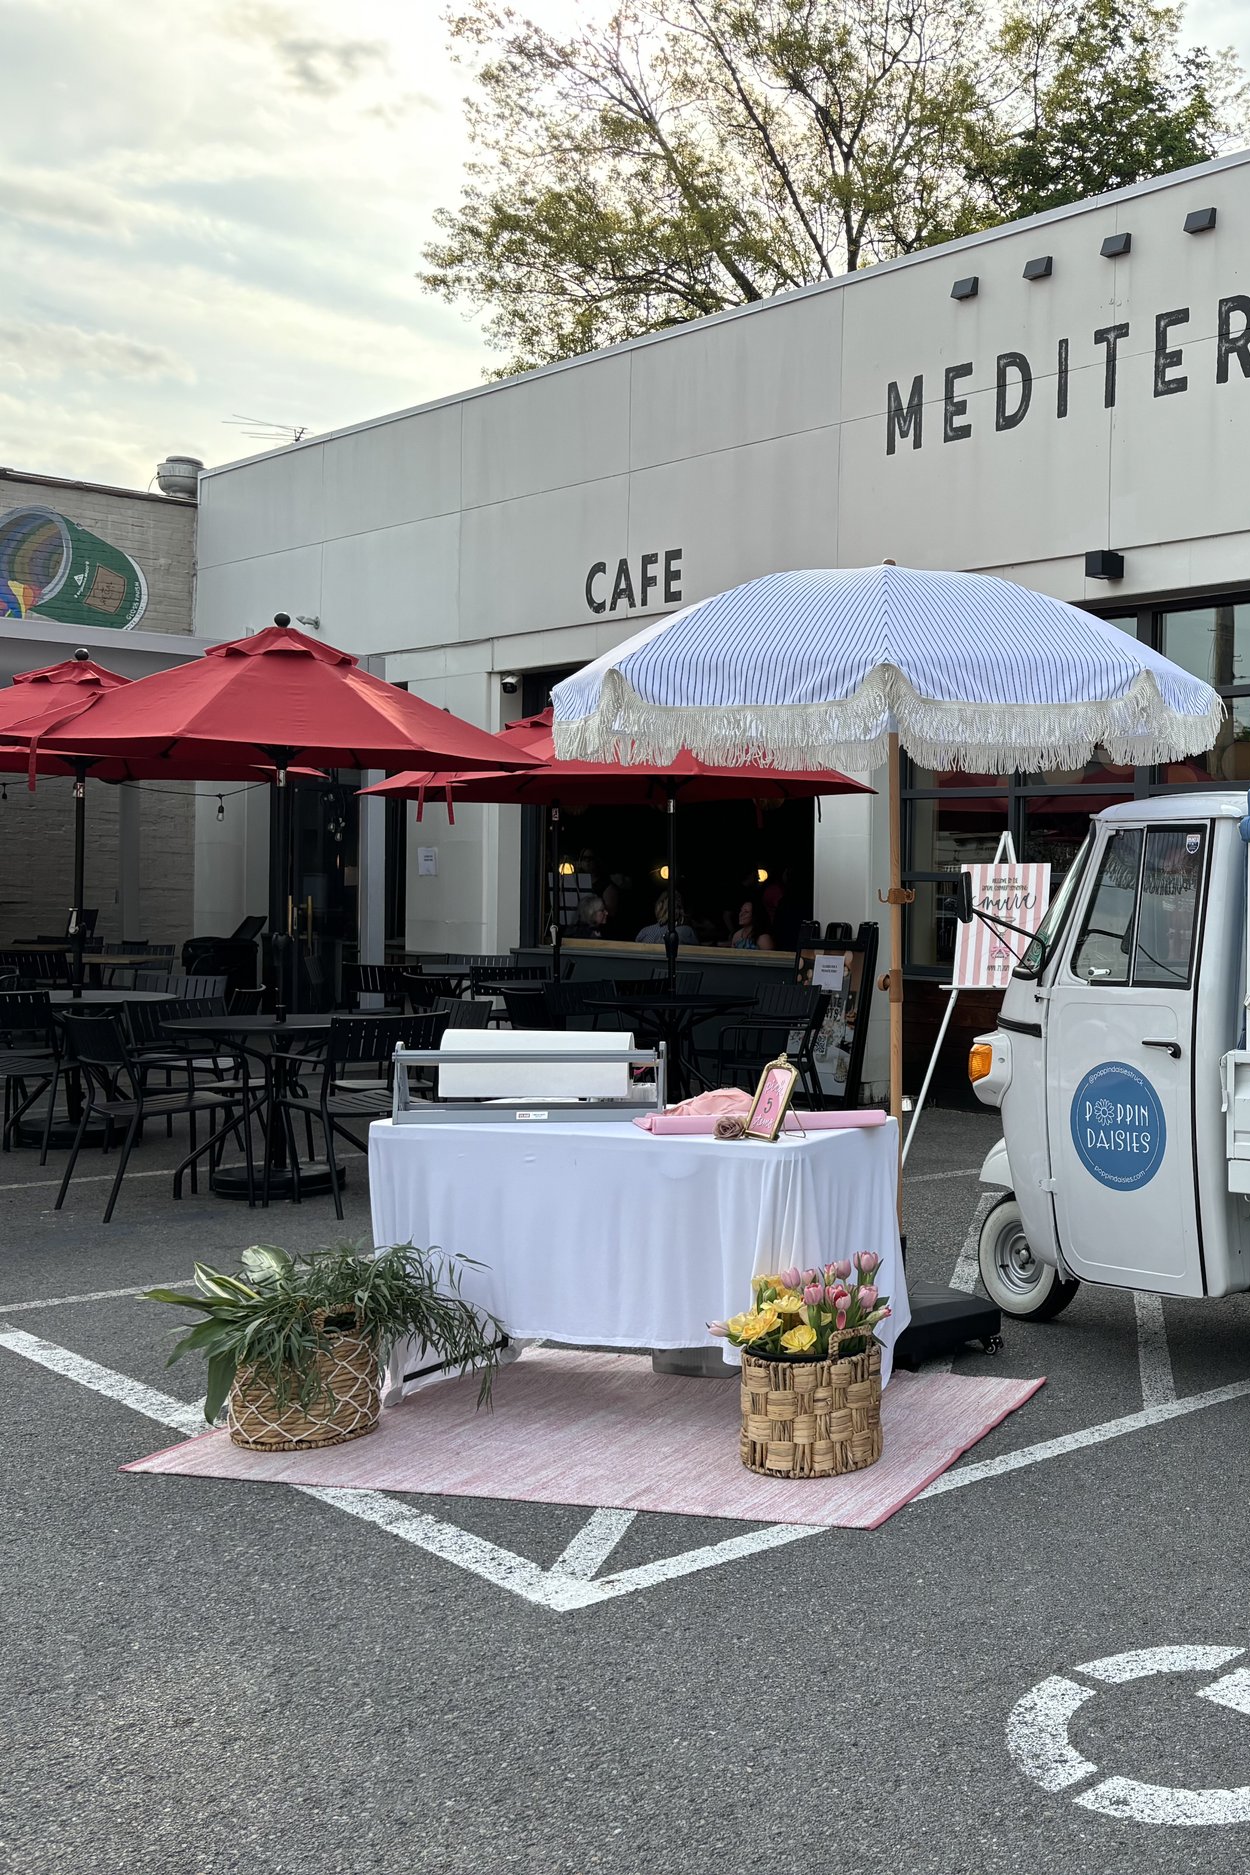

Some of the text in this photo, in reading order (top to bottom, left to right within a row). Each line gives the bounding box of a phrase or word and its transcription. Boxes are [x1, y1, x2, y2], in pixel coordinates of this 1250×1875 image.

[585, 548, 682, 614] CAFE
[1088, 1066, 1144, 1086] @poppindaisiestruck
[763, 1097, 773, 1114] 5
[1087, 1128, 1151, 1154] DAISIES
[1094, 1165, 1146, 1183] poppindaisies.com
